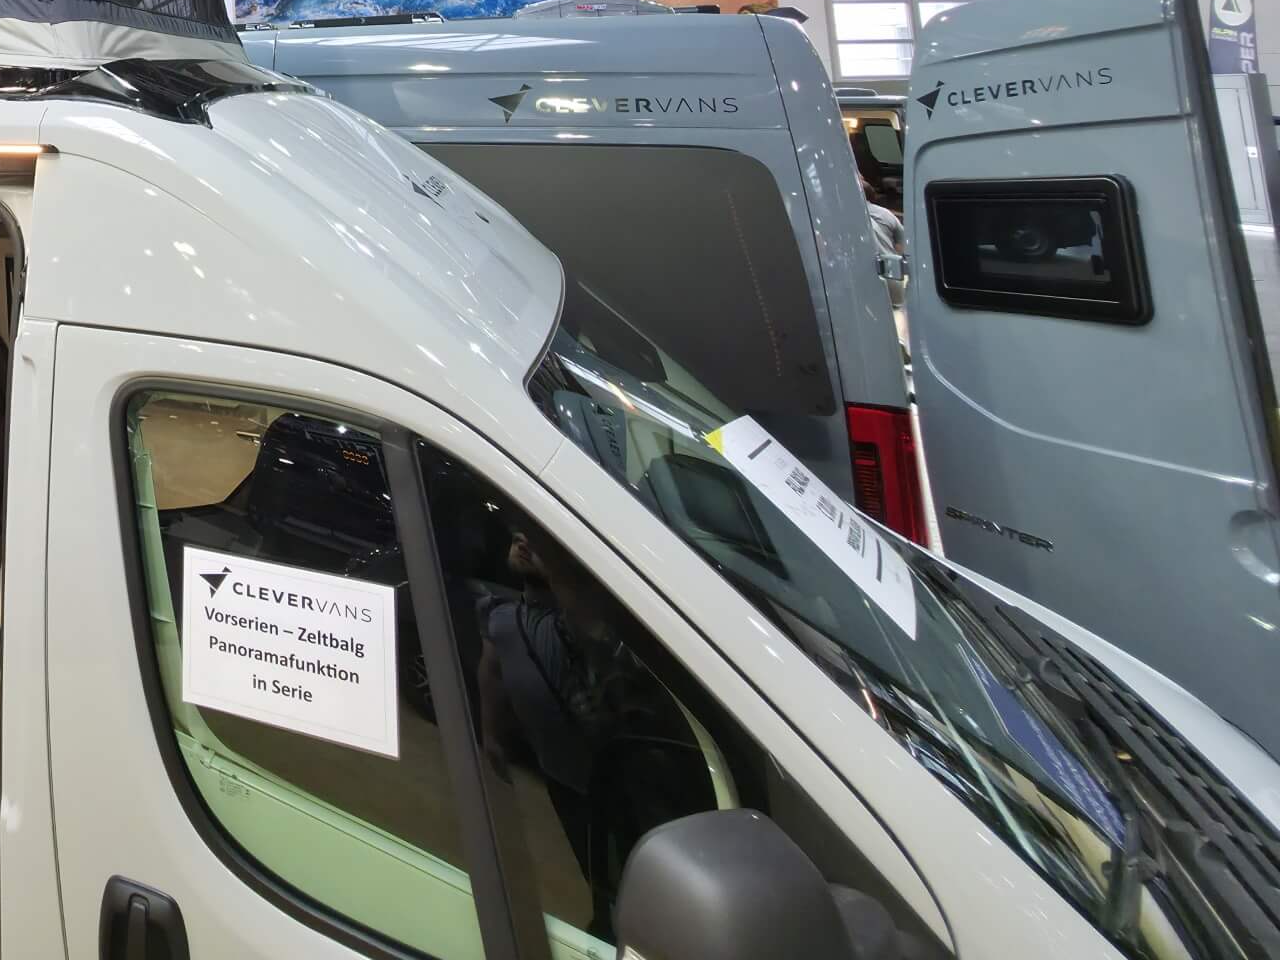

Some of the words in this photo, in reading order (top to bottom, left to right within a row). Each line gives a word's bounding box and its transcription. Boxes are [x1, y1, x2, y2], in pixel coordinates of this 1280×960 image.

[535, 97, 739, 114] CLEVERVANS
[947, 67, 1113, 107] CLEVERVANS
[232, 582, 372, 623] CLEVERVANS
[204, 606, 279, 636] Vorserien
[298, 627, 365, 658] Zeltbalg
[209, 635, 360, 684] Panoramafunktion
[252, 674, 267, 691] in
[272, 679, 313, 703] Serie
